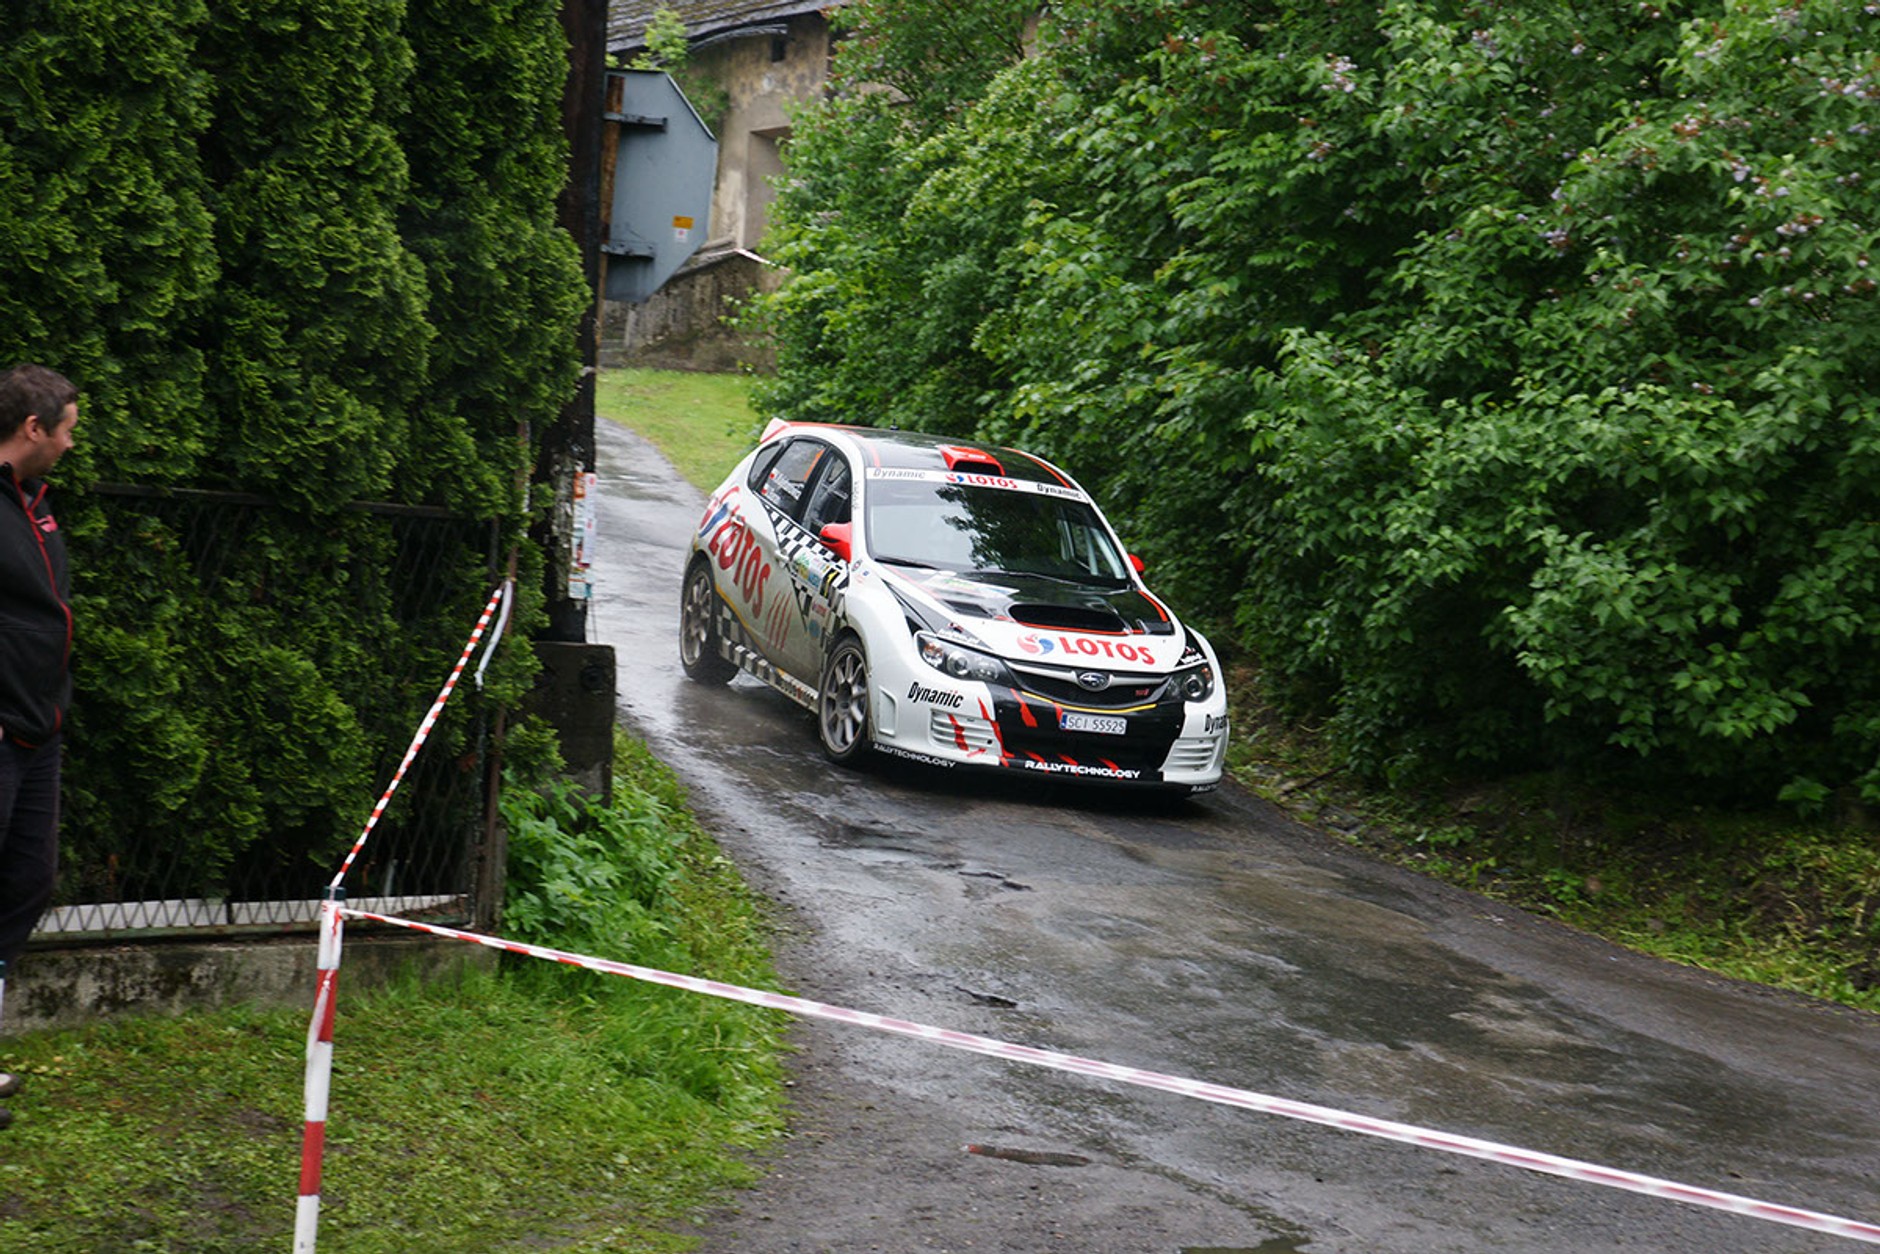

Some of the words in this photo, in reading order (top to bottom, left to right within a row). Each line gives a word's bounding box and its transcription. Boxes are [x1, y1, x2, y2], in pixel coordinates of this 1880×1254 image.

[873, 466, 926, 480] Dynamic
[967, 474, 1018, 489] LOTOS
[708, 504, 771, 620] LOTOS
[1058, 636, 1156, 666] LOTOS
[907, 681, 964, 708] Dynamic
[1066, 714, 1088, 729] SCI
[1092, 717, 1126, 733] 55525
[872, 742, 956, 769] RALLYTECHNOLOGY
[1024, 759, 1141, 780] RALLYTECHNOLOGY
